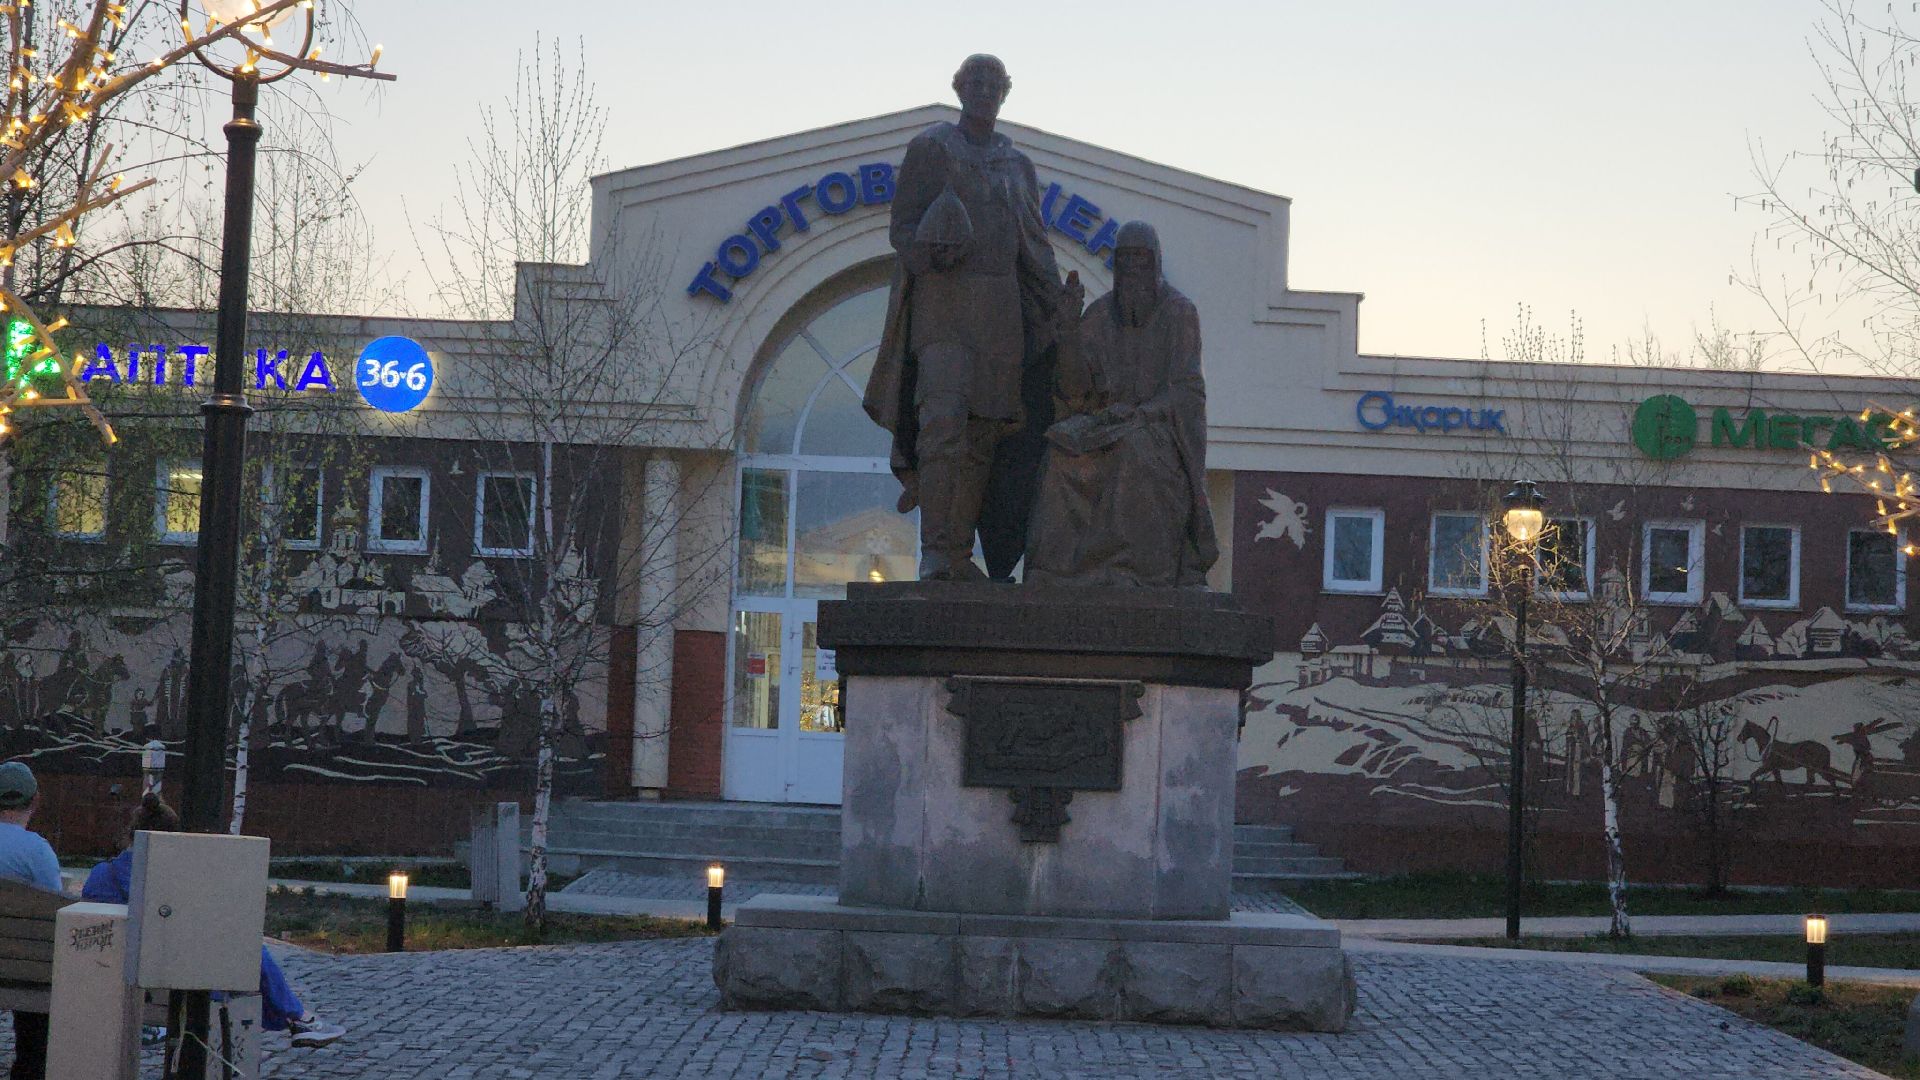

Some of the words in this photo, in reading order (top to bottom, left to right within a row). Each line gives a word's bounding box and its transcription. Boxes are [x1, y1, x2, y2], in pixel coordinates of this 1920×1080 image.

[686, 162, 897, 304] ТОРГОВ
[81, 342, 337, 393] АПТКА
[1356, 390, 1505, 433] Очкарик
